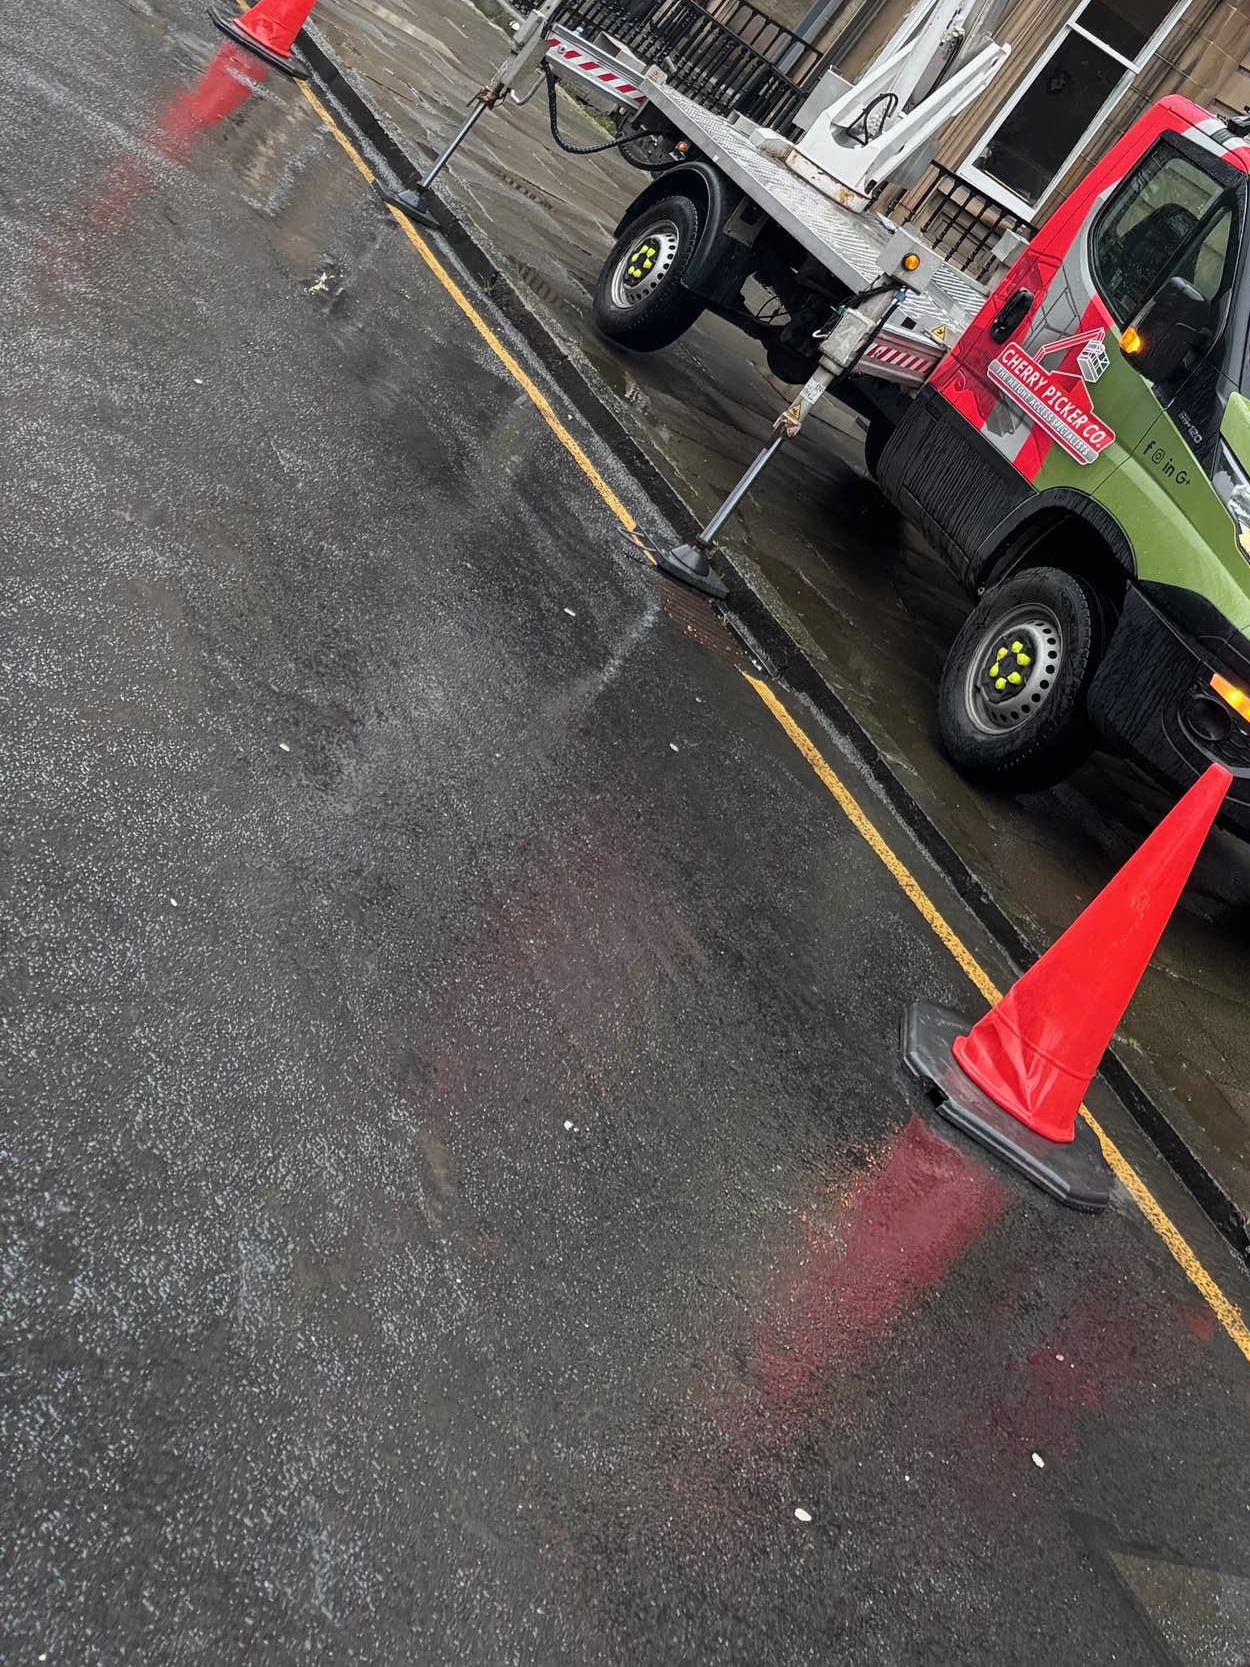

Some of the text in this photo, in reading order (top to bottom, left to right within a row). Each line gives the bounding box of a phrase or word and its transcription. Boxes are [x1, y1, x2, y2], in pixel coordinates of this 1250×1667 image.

[995, 368, 1091, 456] THE HEIGHT ACCESS SPECIALISTS
[1001, 348, 1107, 449] CHERRY PICKER CO.
